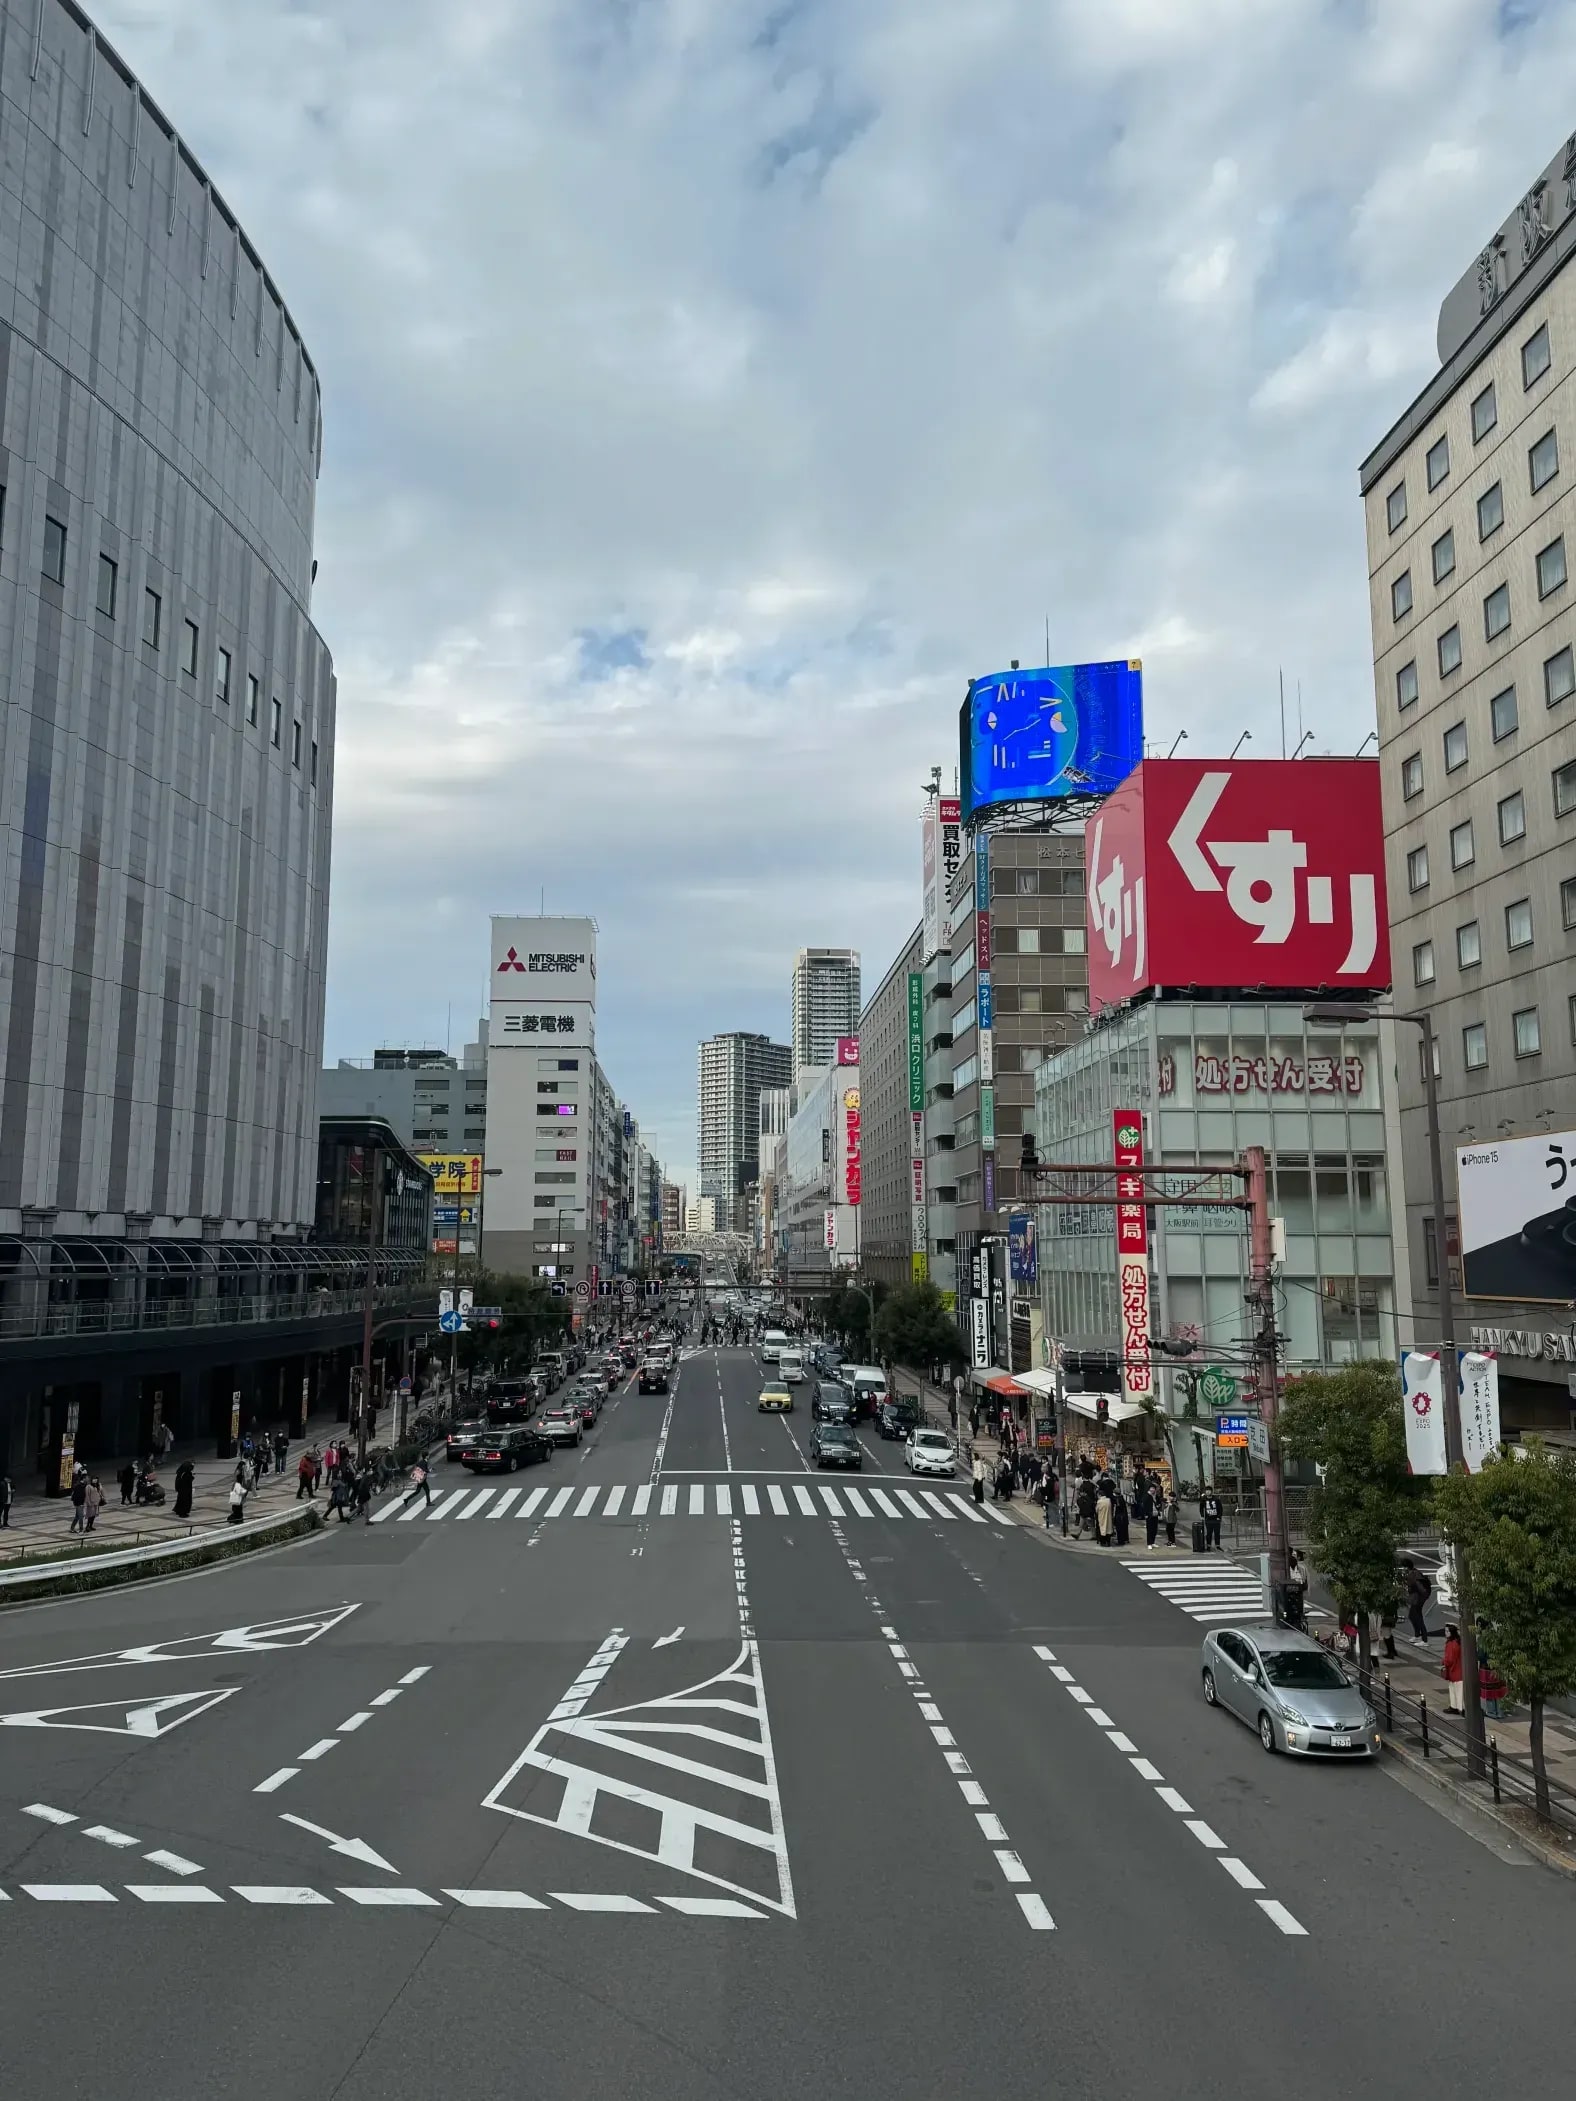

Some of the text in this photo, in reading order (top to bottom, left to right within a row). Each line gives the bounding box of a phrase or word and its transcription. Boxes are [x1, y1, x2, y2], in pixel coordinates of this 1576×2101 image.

[1167, 772, 1377, 974] くすり
[1089, 817, 1144, 982] くすり
[528, 953, 585, 964] MITSUBISHI
[980, 919, 989, 962] ヘッドスパ
[528, 962, 577, 972] ELECTRIC
[504, 1015, 575, 1033] 三菱電機
[980, 988, 990, 1027] ラポート
[911, 1033, 921, 1104] 浜口クリニック
[1196, 1056, 1364, 1094] 処方せん受付
[1466, 1150, 1498, 1166] iPhone 15
[1546, 1144, 1576, 1190] う
[826, 1212, 834, 1246] ジャンカラ
[1122, 1265, 1150, 1391] 処方せん受付
[1227, 1436, 1240, 1444] 入口
